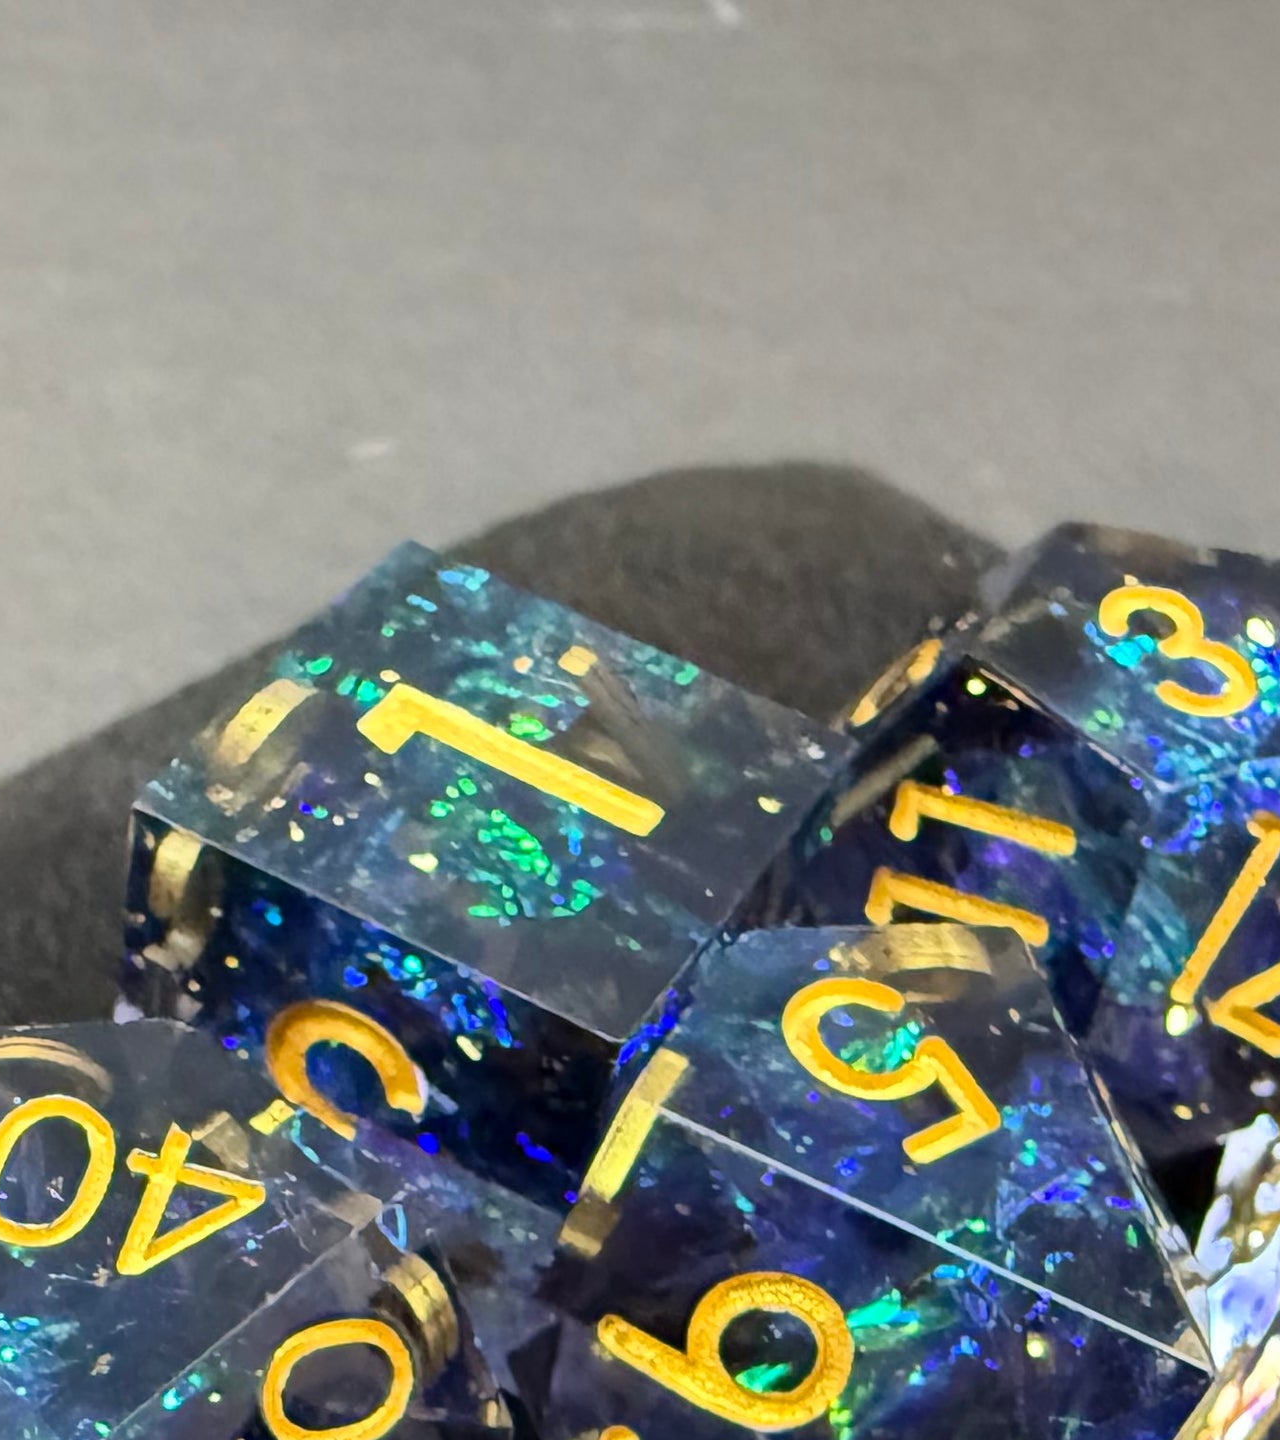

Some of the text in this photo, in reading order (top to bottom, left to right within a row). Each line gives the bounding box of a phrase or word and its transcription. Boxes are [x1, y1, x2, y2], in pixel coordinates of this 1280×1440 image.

[1099, 586, 1257, 716] 3
[357, 683, 665, 837] 1
[865, 778, 1077, 947] 11
[781, 977, 1001, 1164] 5
